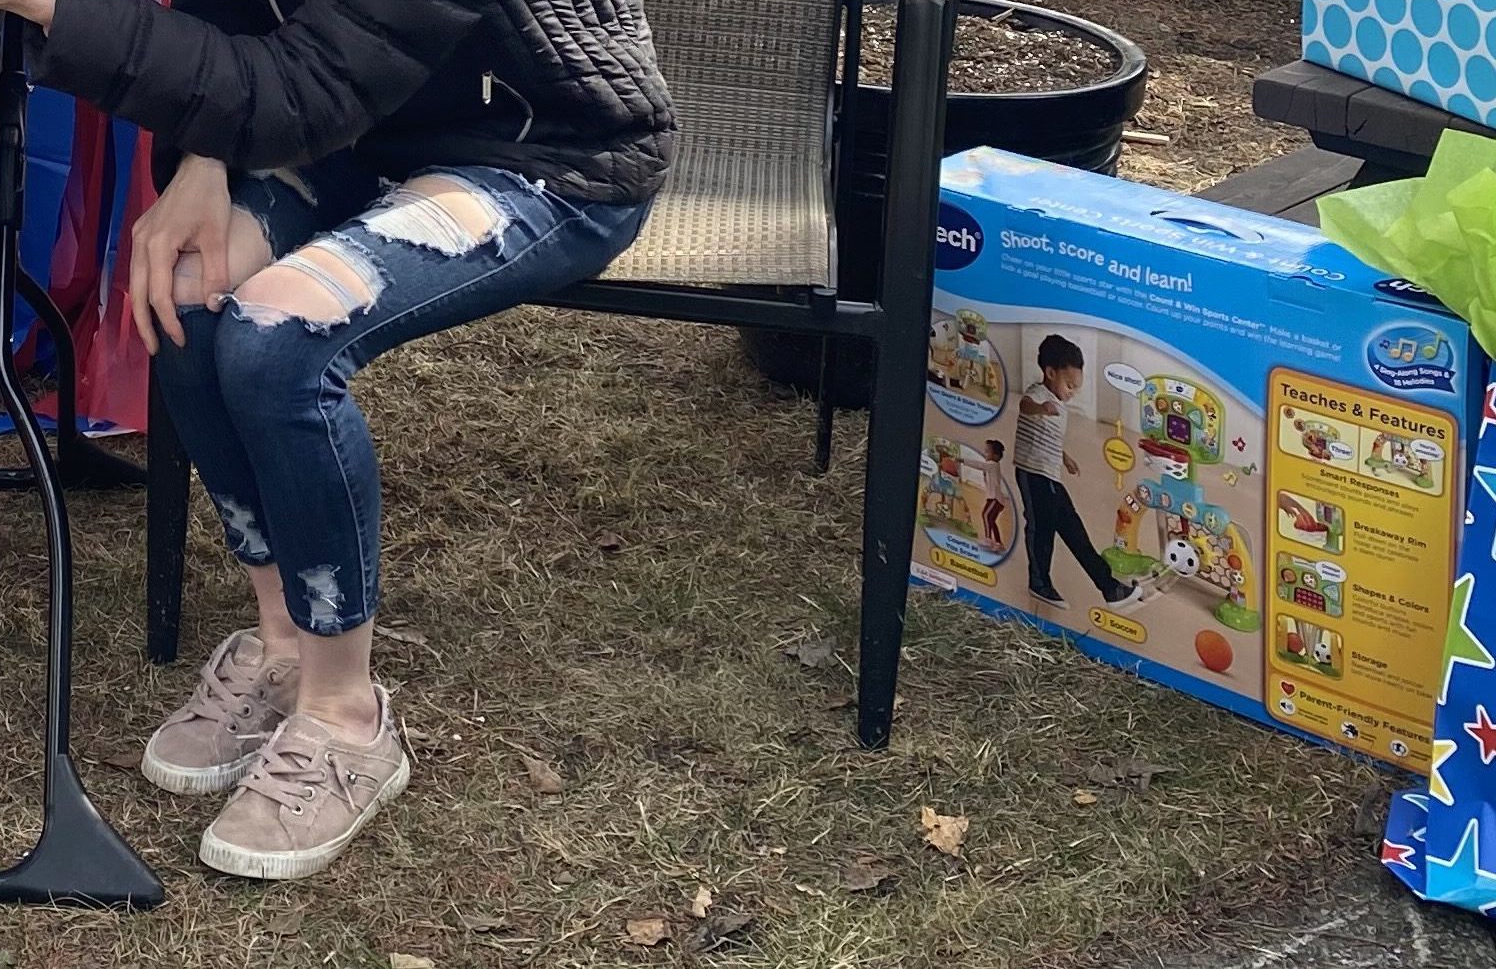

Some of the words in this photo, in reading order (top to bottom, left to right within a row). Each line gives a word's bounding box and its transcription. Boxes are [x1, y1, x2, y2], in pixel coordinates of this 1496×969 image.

[937, 226, 976, 252] ech
[1000, 231, 1054, 254] Shoot,
[1059, 241, 1105, 266] score
[1108, 259, 1141, 282] and
[1145, 266, 1193, 293] learn!
[1149, 293, 1173, 307] Count
[1183, 302, 1200, 313] Win
[1203, 307, 1229, 322] Sports
[1281, 383, 1347, 412] Teaches
[1352, 404, 1363, 418] &
[1369, 408, 1446, 440] Features
[1320, 469, 1347, 484] Smart
[1350, 477, 1400, 499] Responses
[1354, 521, 1405, 543] Breakaway
[1408, 535, 1427, 548] Rim
[1353, 584, 1386, 601] Shapes
[1389, 595, 1395, 603] &
[1398, 598, 1429, 613] Colors
[1094, 612, 1101, 623] 2
[1352, 651, 1388, 669] Storage
[1300, 691, 1380, 727] Parent-Friendly
[1383, 721, 1430, 744] Features
